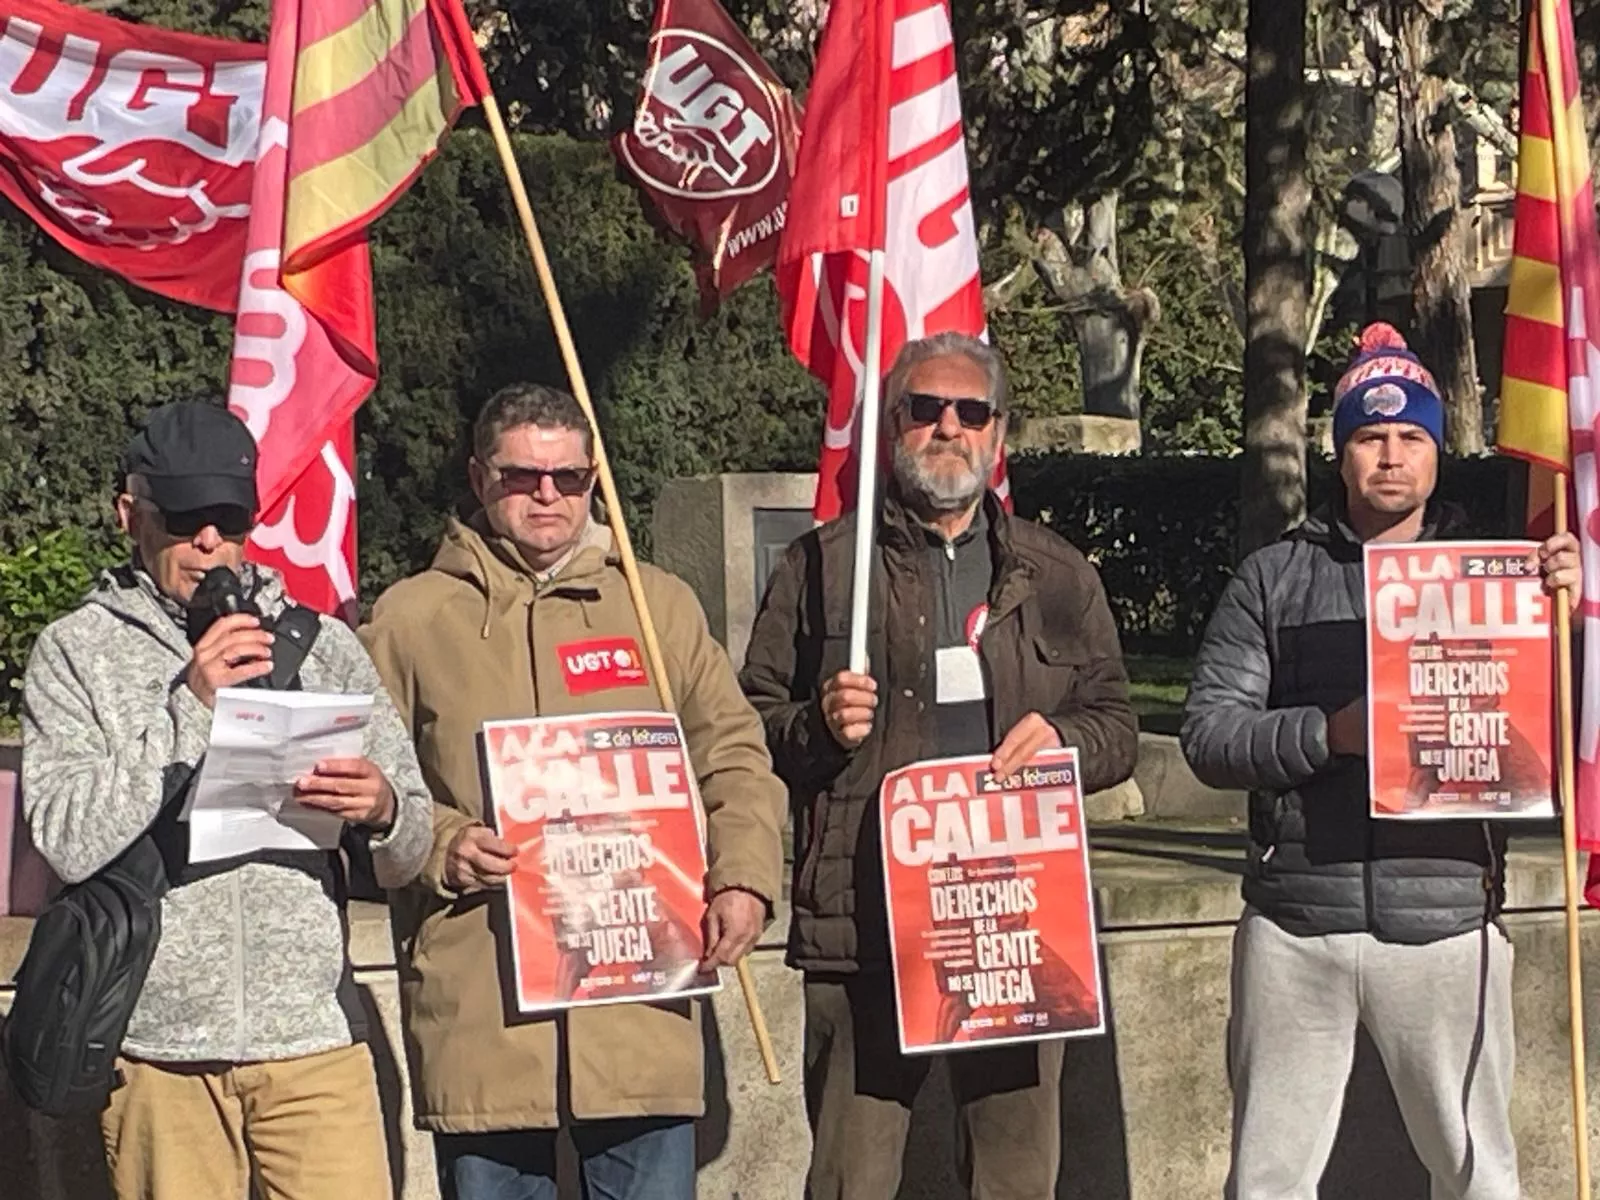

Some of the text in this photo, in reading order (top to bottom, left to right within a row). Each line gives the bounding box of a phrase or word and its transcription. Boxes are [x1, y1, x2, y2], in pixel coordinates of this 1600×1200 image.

[0, 16, 268, 168] UGT
[642, 43, 773, 163] UGT
[1377, 553, 1454, 581] A LA
[1468, 559, 1485, 575] 2
[1487, 558, 1504, 575] de
[1374, 579, 1549, 642] CALLE
[566, 650, 612, 675] UGT
[1409, 660, 1510, 696] DERECHOS
[501, 728, 580, 759] A LA
[593, 728, 678, 749] 2 de febrero
[1450, 711, 1510, 747] GENTE
[1023, 767, 1072, 788] febrero
[1437, 747, 1500, 782] JUEGA
[501, 750, 689, 823] CALLE
[892, 771, 970, 804] A LA
[890, 790, 1079, 867] CALLE
[547, 834, 654, 877] DERECHOS
[593, 886, 661, 926] GENTE
[929, 876, 1038, 922] DERECHOS
[587, 925, 654, 966] JUEGA
[975, 929, 1043, 970] GENTE
[968, 968, 1036, 1009] JUEGA
